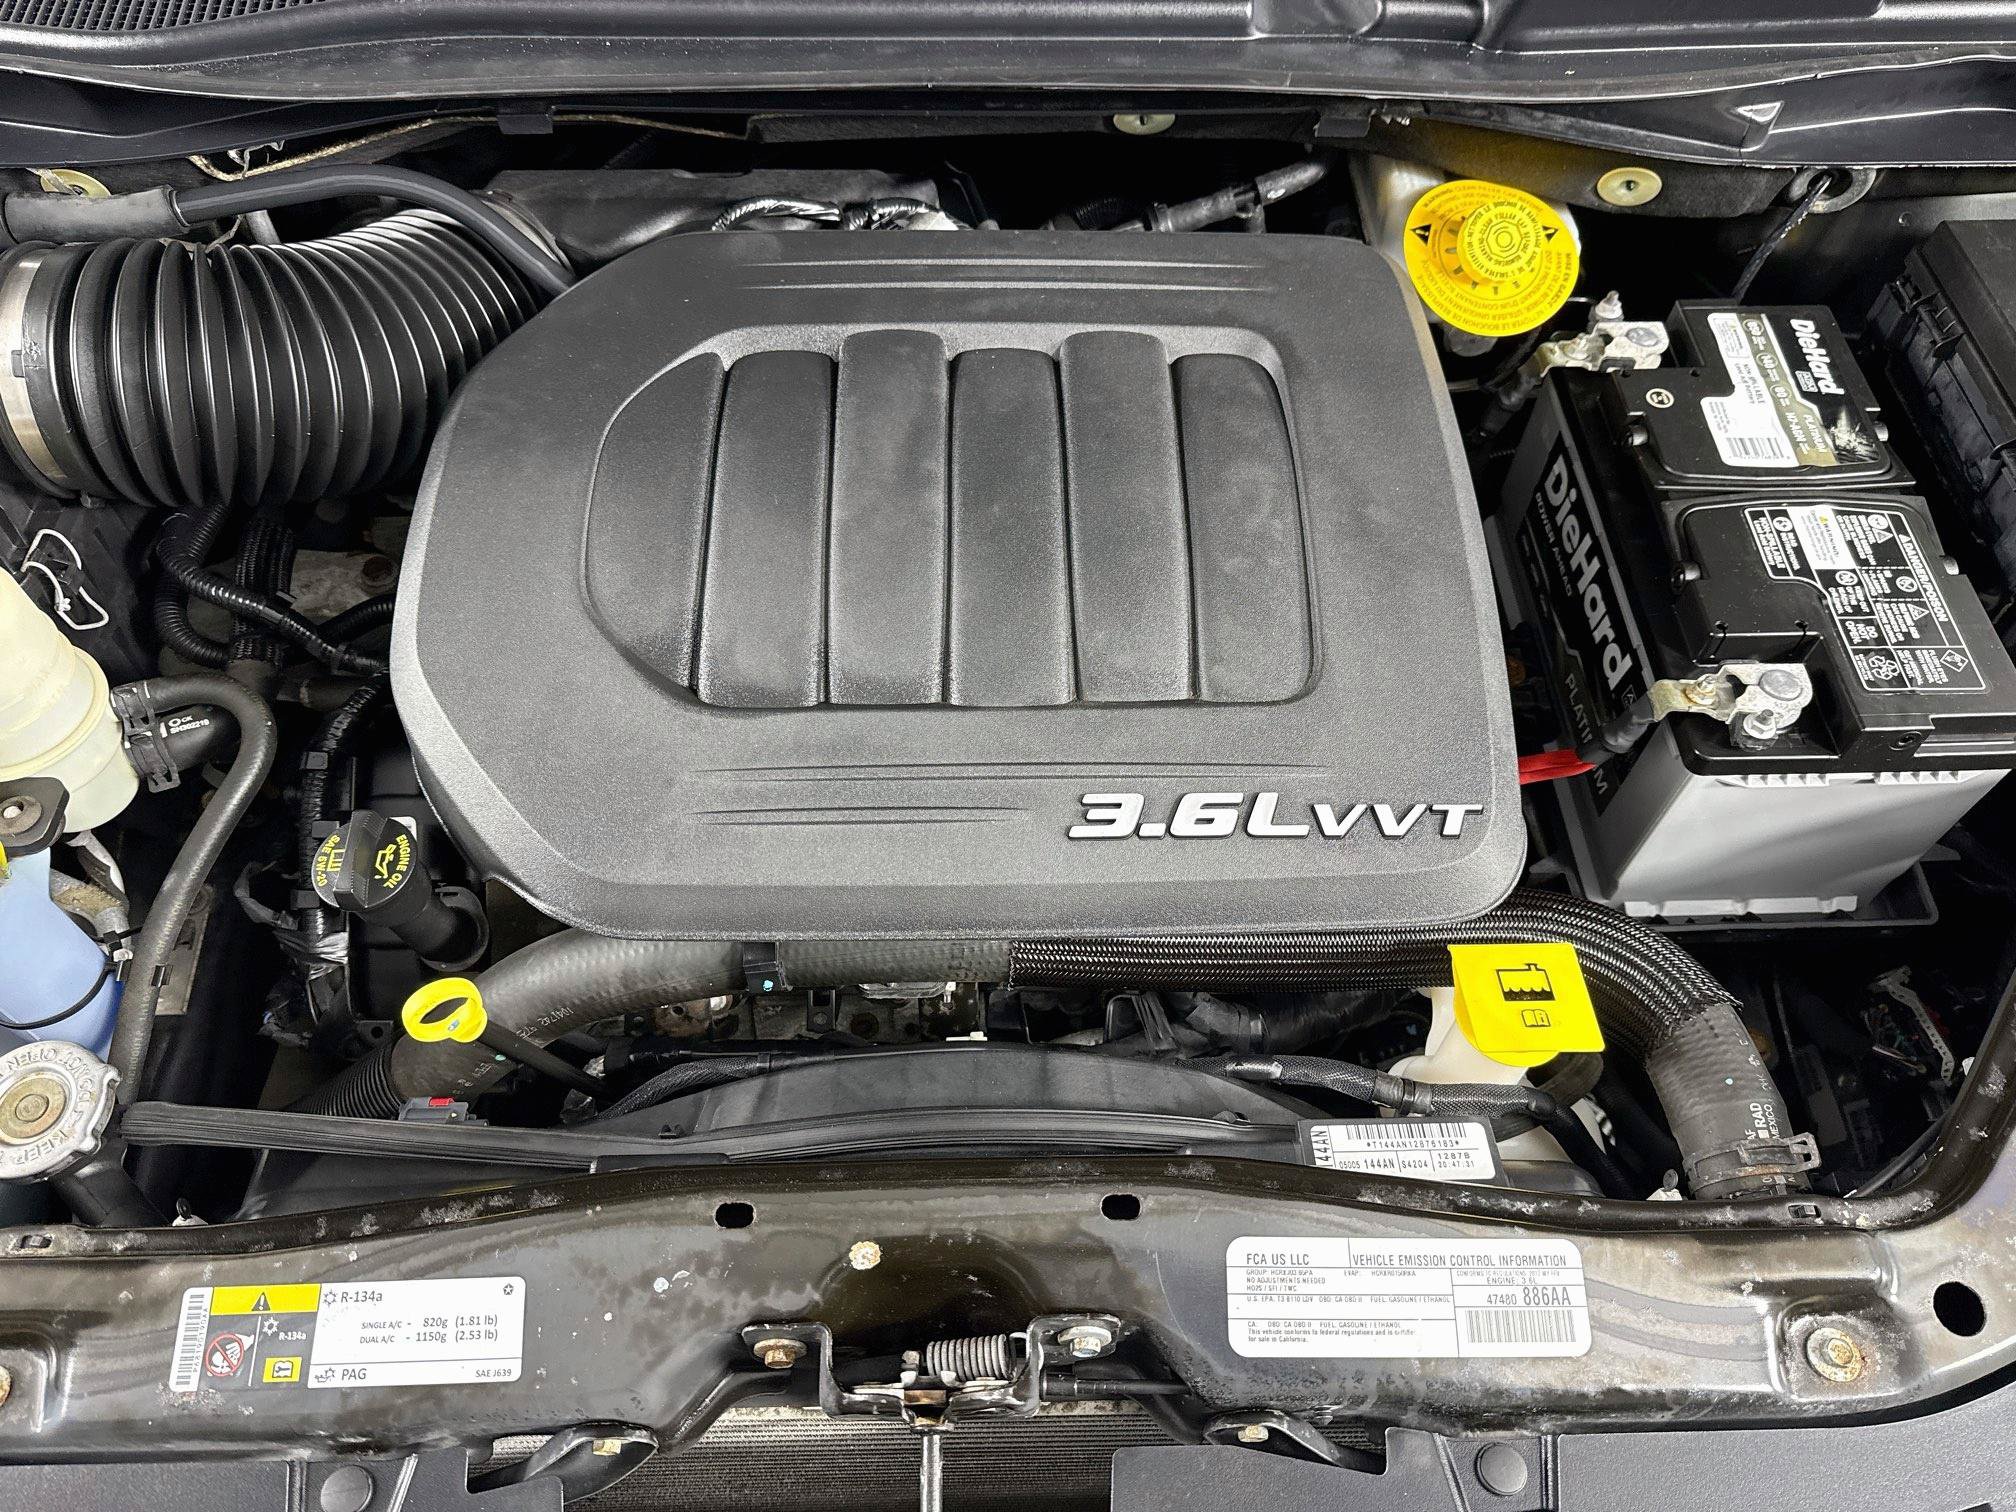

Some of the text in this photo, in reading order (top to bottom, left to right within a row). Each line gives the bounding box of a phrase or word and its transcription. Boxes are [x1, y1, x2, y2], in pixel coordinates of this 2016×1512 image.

[1790, 319, 1845, 395] DieHard
[1544, 455, 1633, 690] DieHard
[1904, 541, 1949, 622] DANGER/POISON
[1856, 624, 1870, 640] NOT
[1866, 626, 1878, 638] DO
[1068, 792, 1484, 840] 3.6L VVT
[322, 835, 340, 854] SAE
[383, 834, 411, 889] ENGINE OIL
[1750, 1102, 1767, 1128] RAD
[1764, 1104, 1780, 1139] MEXICO
[1364, 1158, 1395, 1169] 144AN
[1401, 1161, 1428, 1169] S4204
[1246, 1253, 1310, 1266] FCA US LLC
[1352, 1254, 1567, 1266] VEHICLE EMISSION CONTROL INFORMATION
[340, 1290, 383, 1303] R-134a
[1487, 1287, 1571, 1306] 47480 886AA
[361, 1314, 498, 1330] SINGLE A/C 820g (1.81 lb)
[359, 1329, 498, 1344] DUAL A/C 1150g (2.53 lb)
[1342, 1329, 1374, 1337] regulations
[341, 1368, 367, 1381] PAG
[475, 1368, 512, 1378] SAE J639
